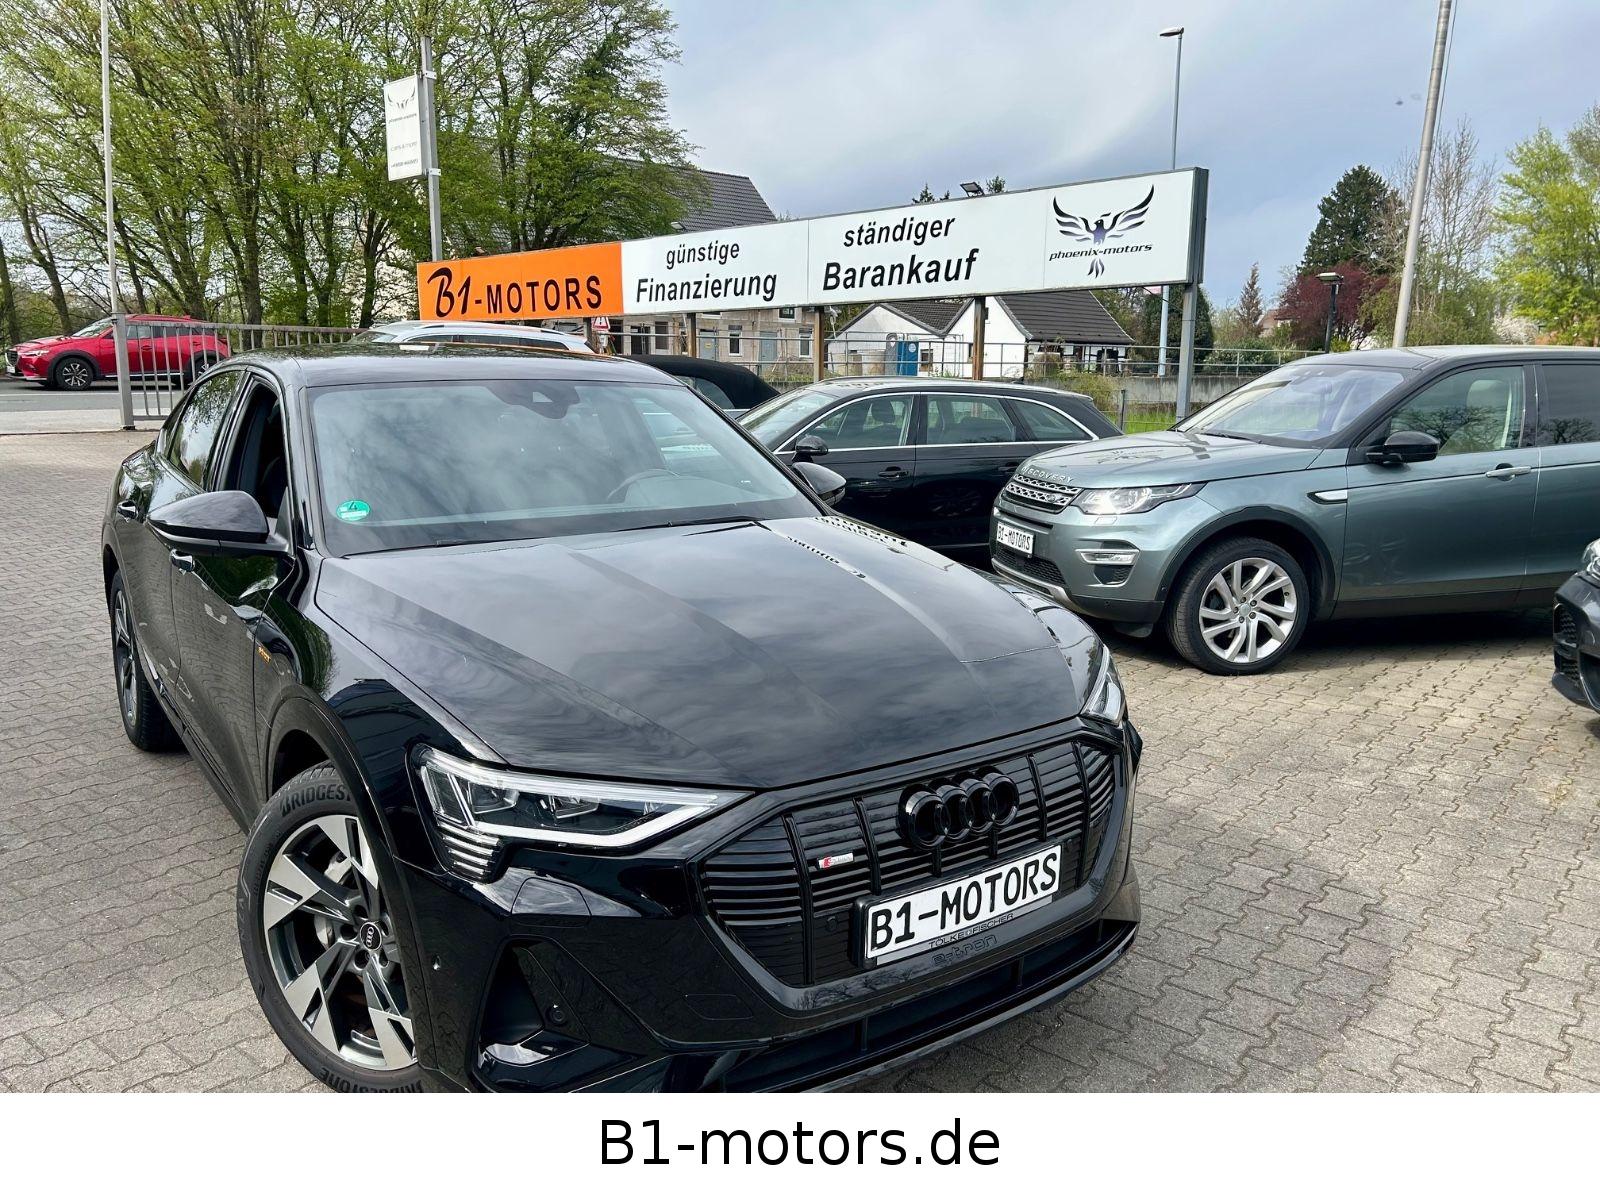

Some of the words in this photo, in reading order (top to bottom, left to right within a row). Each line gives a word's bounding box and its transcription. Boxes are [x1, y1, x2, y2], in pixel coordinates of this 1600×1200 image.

[843, 214, 956, 248] ständiger
[666, 239, 740, 270] günstige
[823, 247, 980, 291] Barankauf
[1048, 243, 1153, 261] phoenix-motors
[427, 267, 602, 318] B1-MOTORS
[636, 271, 778, 304] Finanzierung
[870, 852, 1058, 951] B1-MOTORS
